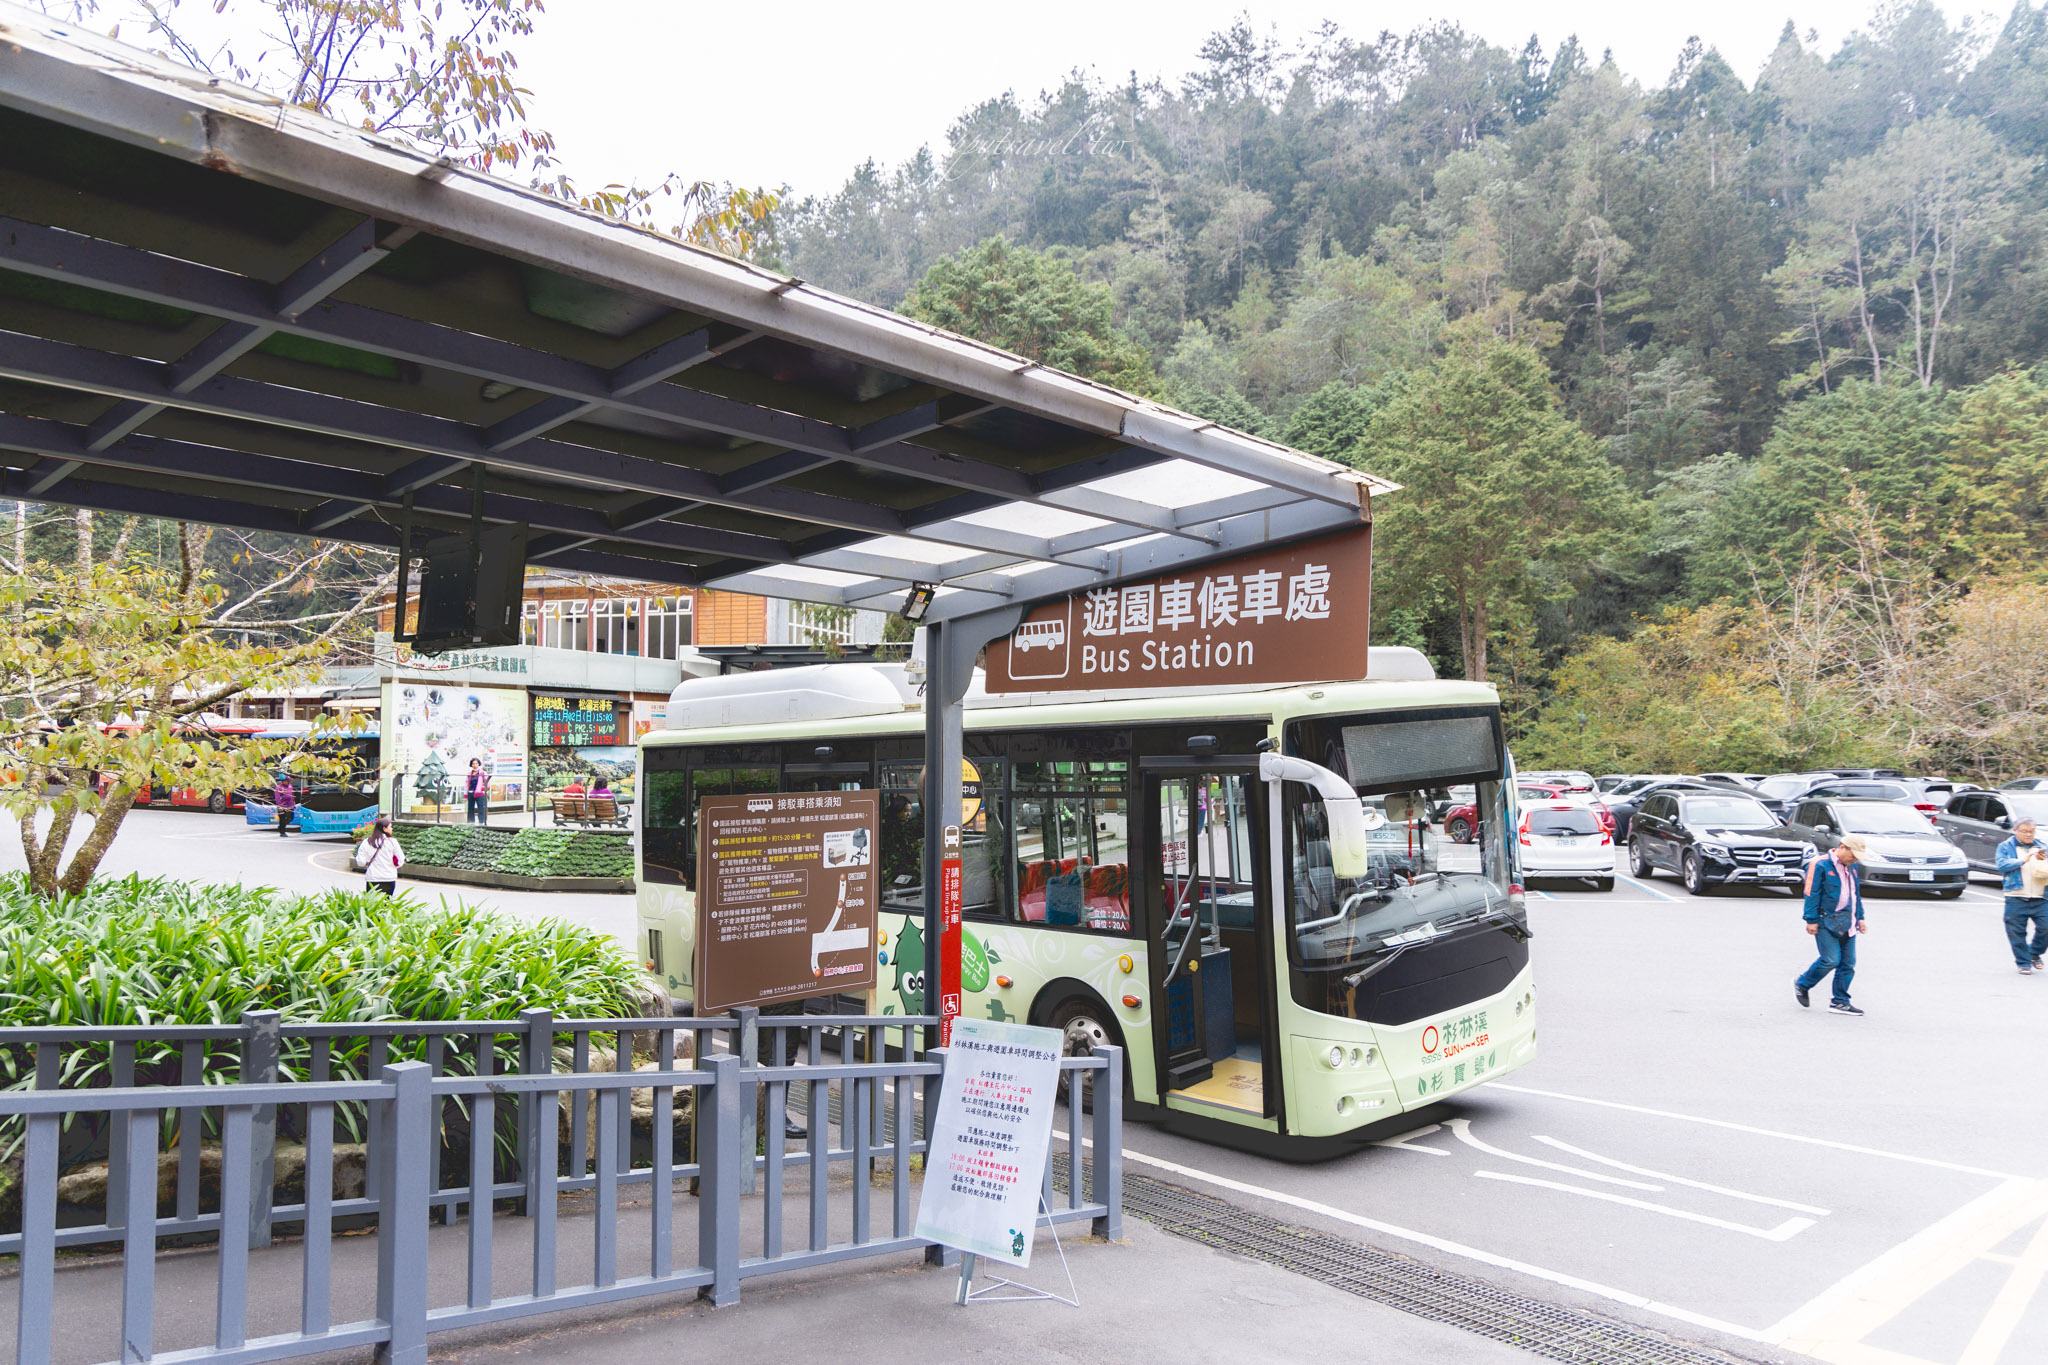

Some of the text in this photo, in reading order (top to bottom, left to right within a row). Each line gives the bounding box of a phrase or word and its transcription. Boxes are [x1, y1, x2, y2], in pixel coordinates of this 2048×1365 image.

[1083, 563, 1332, 638] 遊園車候車處
[1082, 634, 1254, 674] Bus Station
[777, 796, 842, 811] 接駁車搭乘須知
[950, 867, 959, 924] 請排隊上車
[1442, 1011, 1488, 1045] 杉林溪
